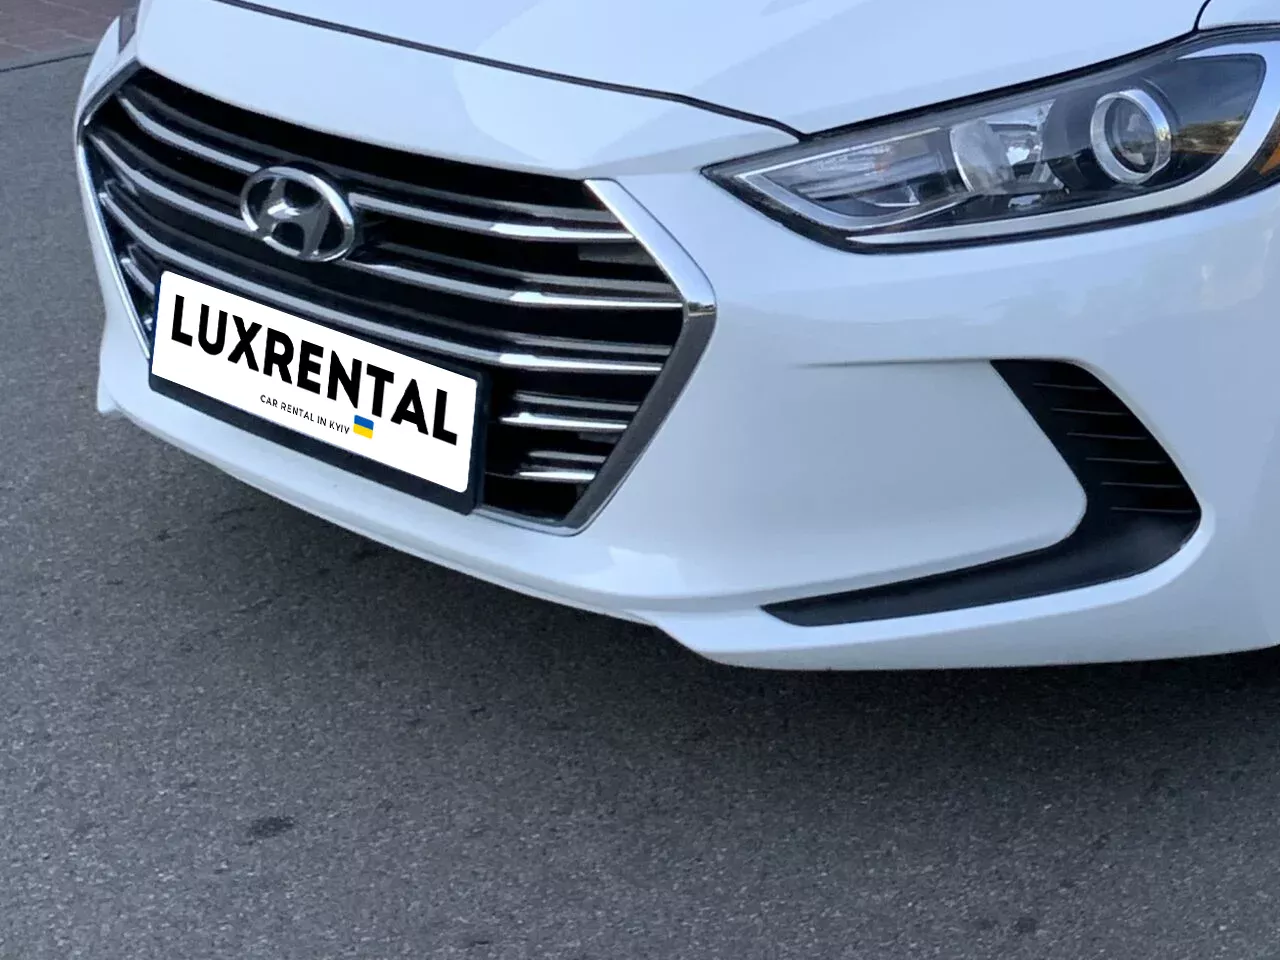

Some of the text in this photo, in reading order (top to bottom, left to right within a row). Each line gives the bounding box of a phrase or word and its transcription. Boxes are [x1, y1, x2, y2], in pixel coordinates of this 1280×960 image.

[171, 294, 458, 446] LUXRENTAL
[260, 394, 350, 434] CAR RENTAL IN KYIV
